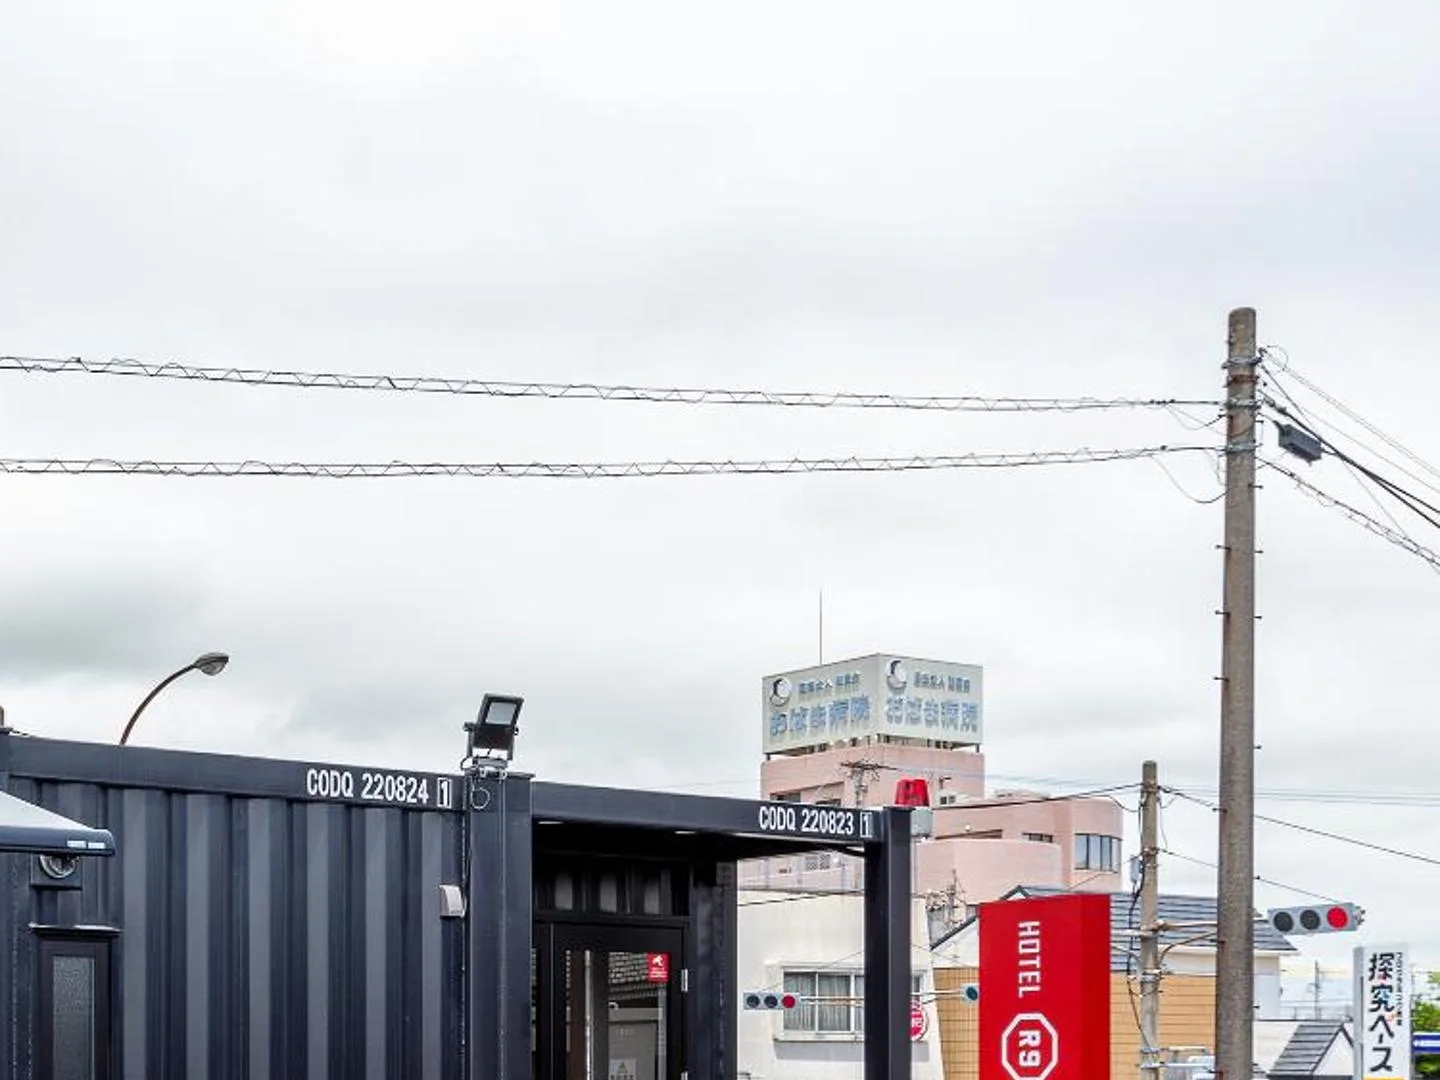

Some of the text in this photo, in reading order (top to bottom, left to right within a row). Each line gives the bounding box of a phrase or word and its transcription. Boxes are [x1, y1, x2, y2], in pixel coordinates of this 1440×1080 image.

[307, 768, 353, 798] CODQ
[361, 773, 429, 804] 220824
[760, 806, 795, 831] CODQ
[801, 809, 854, 835] 220823
[1017, 920, 1041, 998] HOTEL
[1018, 1029, 1042, 1068] R9
